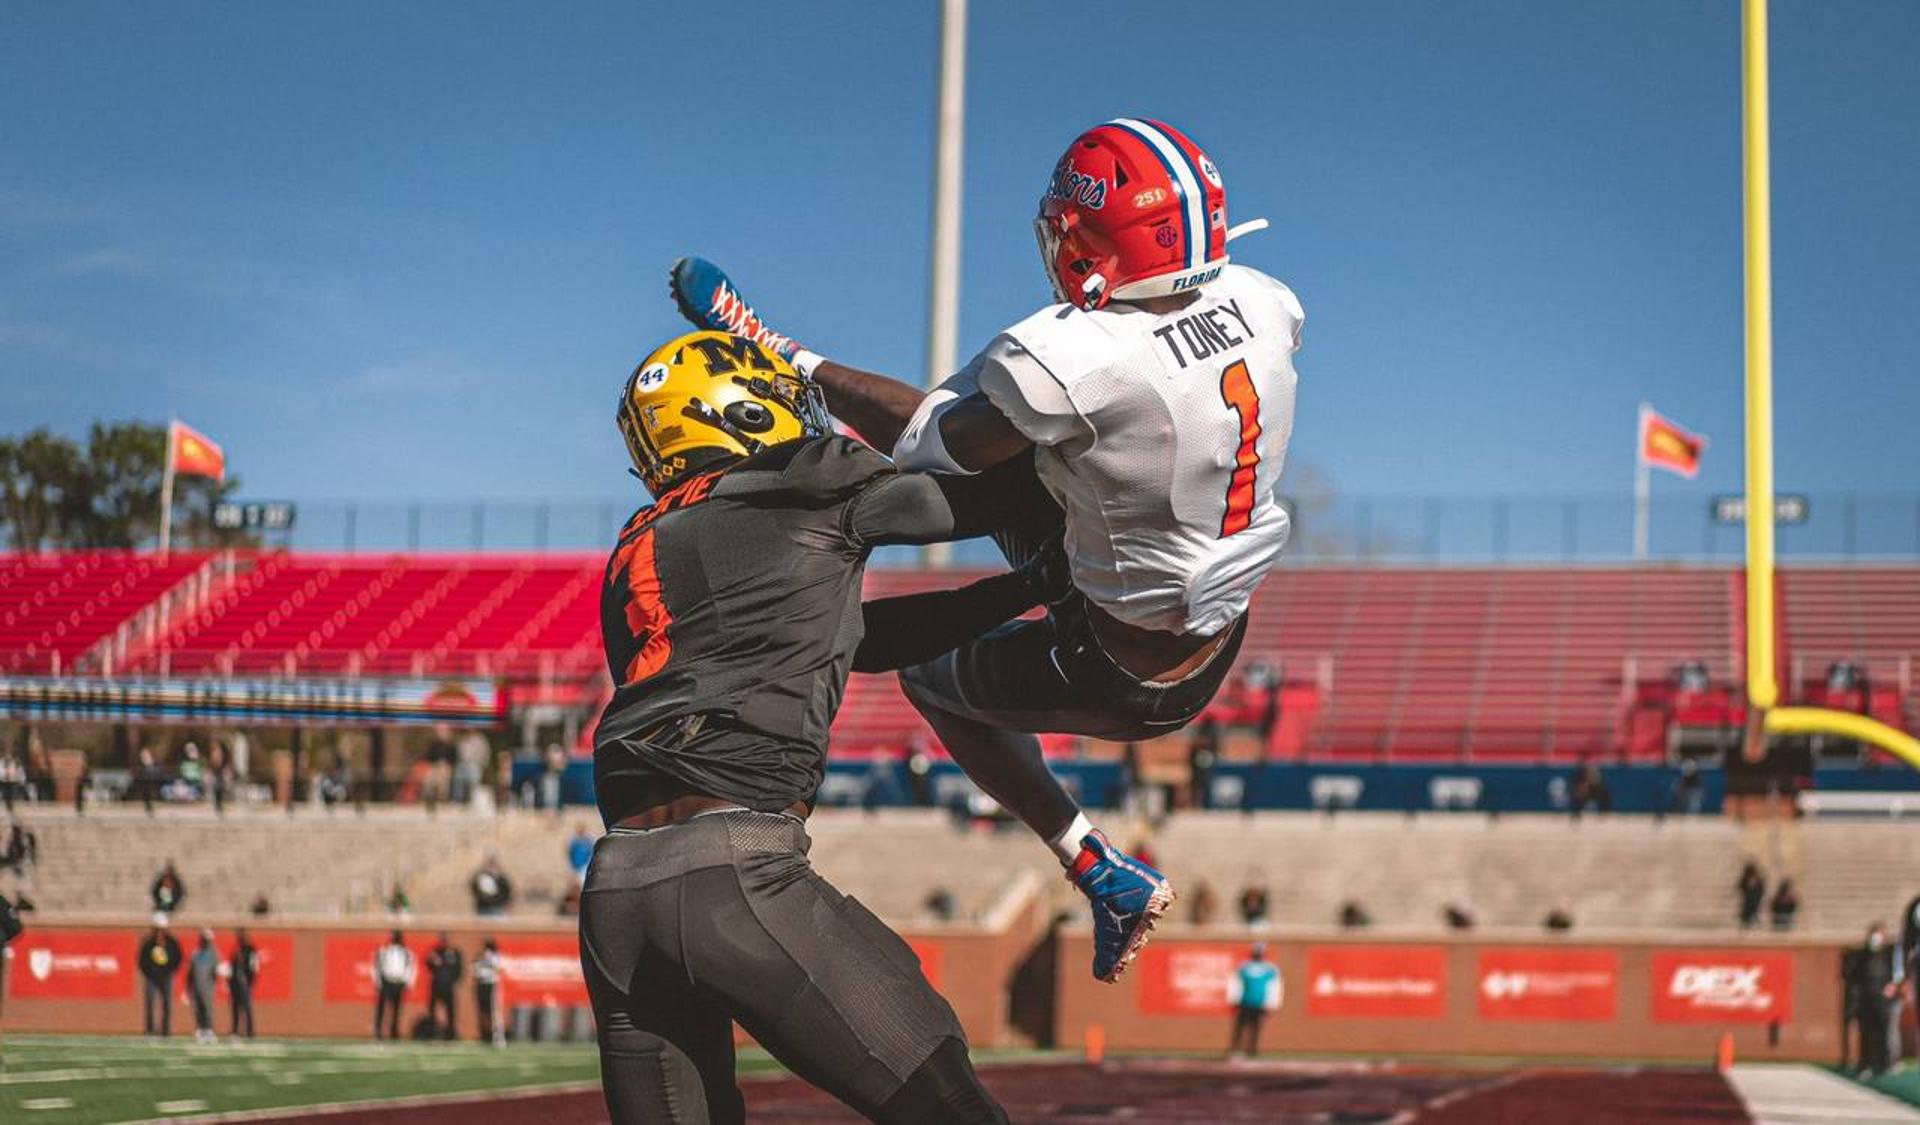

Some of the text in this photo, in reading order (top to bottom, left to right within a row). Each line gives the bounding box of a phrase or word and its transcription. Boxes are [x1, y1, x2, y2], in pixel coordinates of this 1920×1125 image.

[1135, 190, 1163, 208] 251
[1153, 298, 1255, 369] TONEY
[640, 368, 664, 386] 44
[685, 335, 777, 377] M
[1216, 358, 1262, 540] 1
